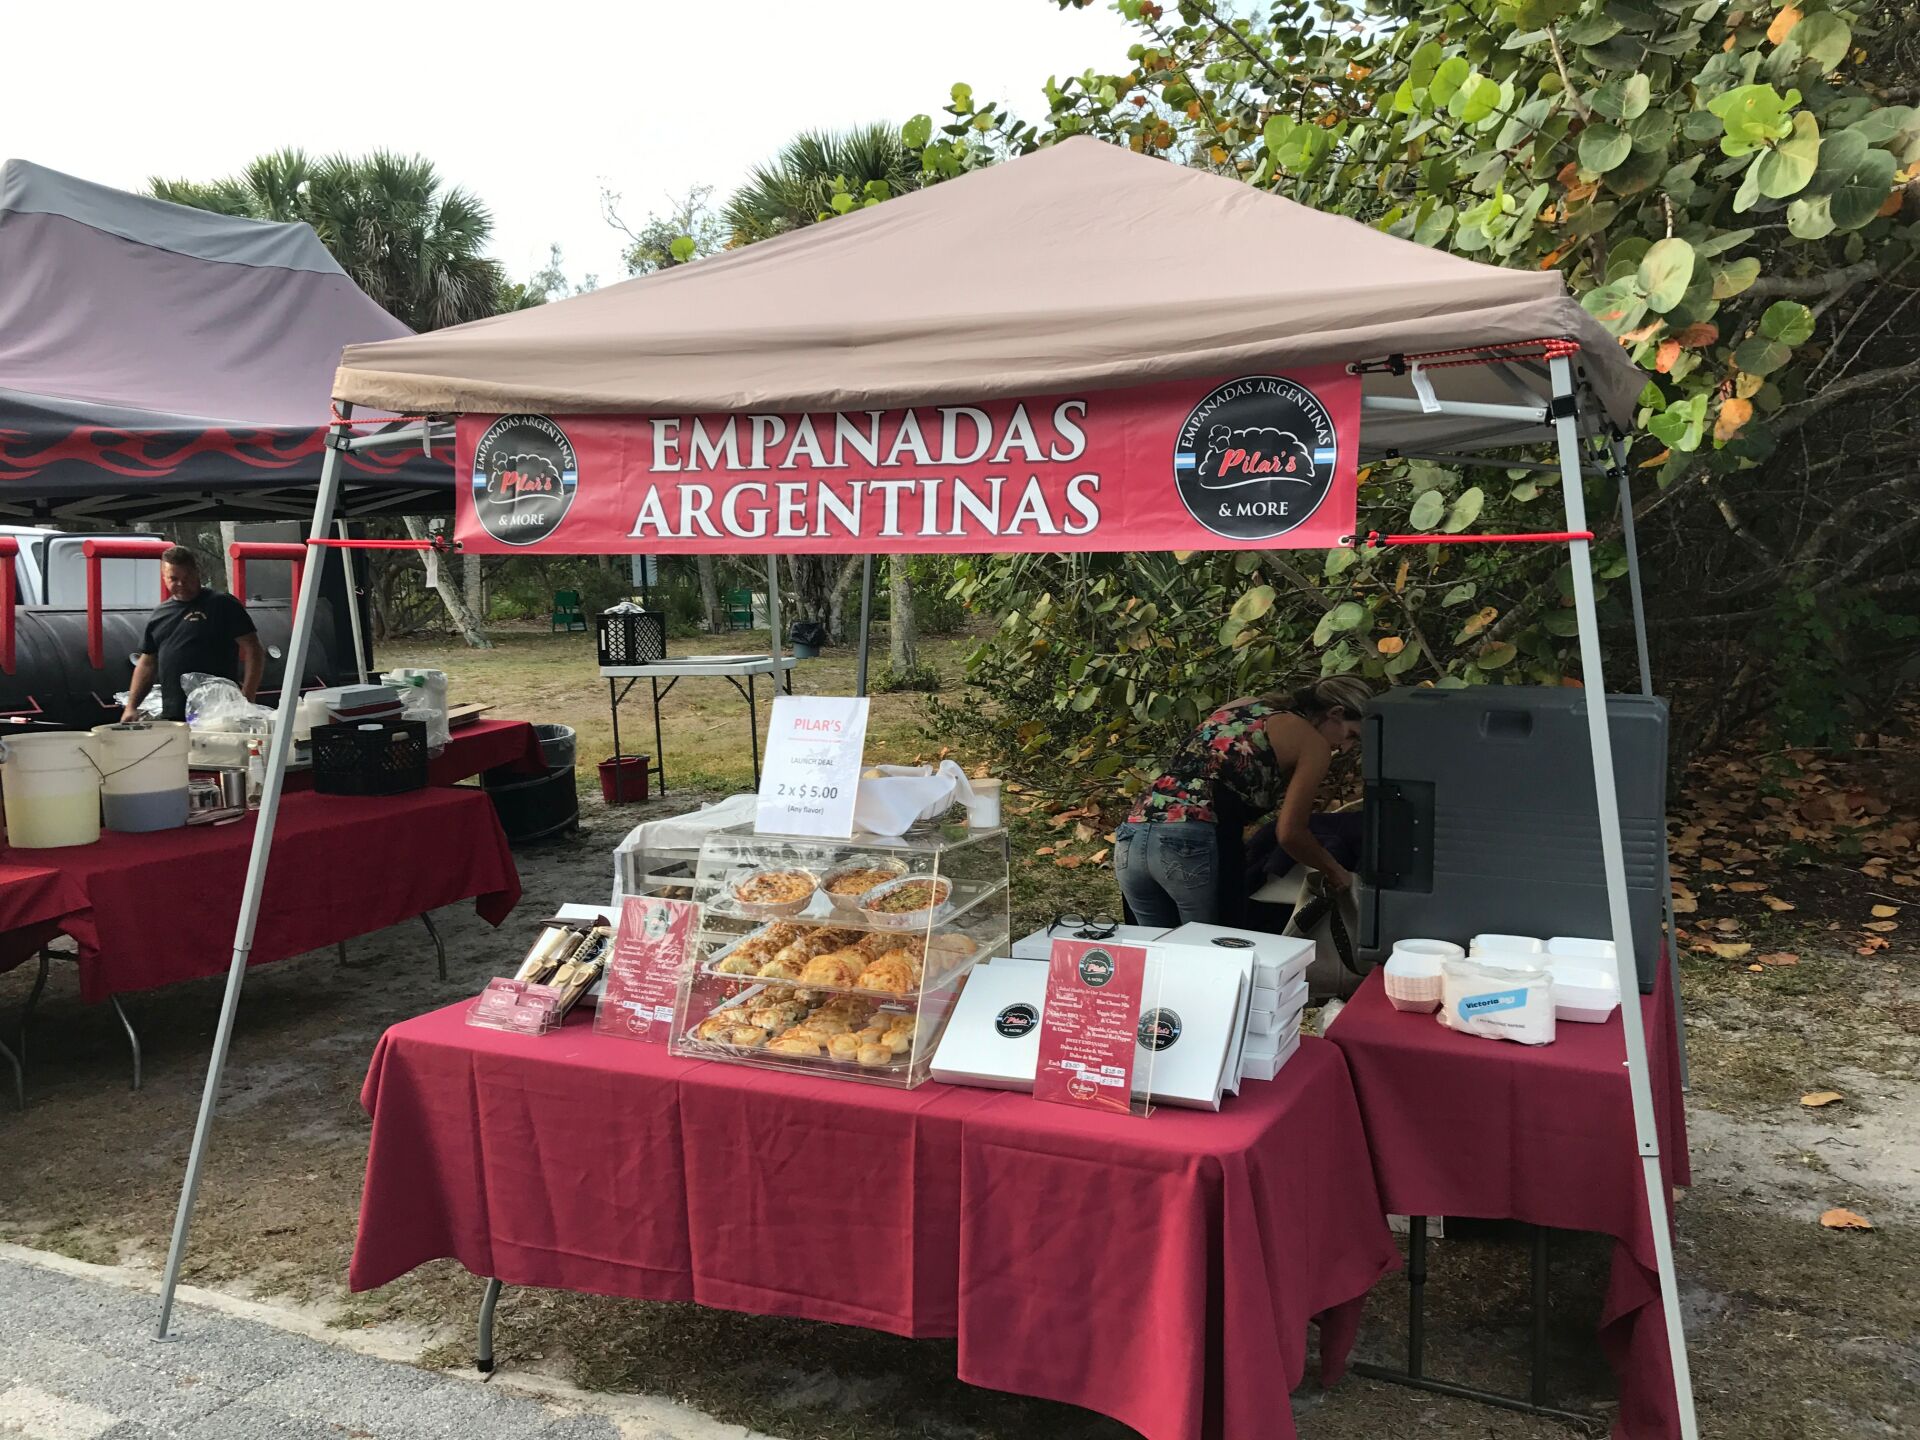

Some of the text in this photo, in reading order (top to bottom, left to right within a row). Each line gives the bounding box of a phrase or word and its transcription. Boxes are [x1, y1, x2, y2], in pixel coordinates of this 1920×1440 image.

[1182, 381, 1331, 448] EMPANADAS ARGENTINAS
[476, 416, 574, 470] EMPANADAS ARGENTINAS
[649, 400, 1088, 472] EMPANADAS
[1218, 448, 1296, 478] Pilar's
[626, 473, 1101, 538] ARGENTINAS
[1218, 502, 1288, 517] & MORE
[499, 514, 544, 526] & MORE
[794, 718, 841, 732] PILAR'S
[791, 757, 834, 766] LAUNCH DEAL
[778, 784, 786, 795] 2
[799, 784, 806, 799] $
[810, 786, 838, 799] 5.00
[788, 806, 824, 815] (Any flavor)
[1466, 999, 1499, 1008] Victoria
